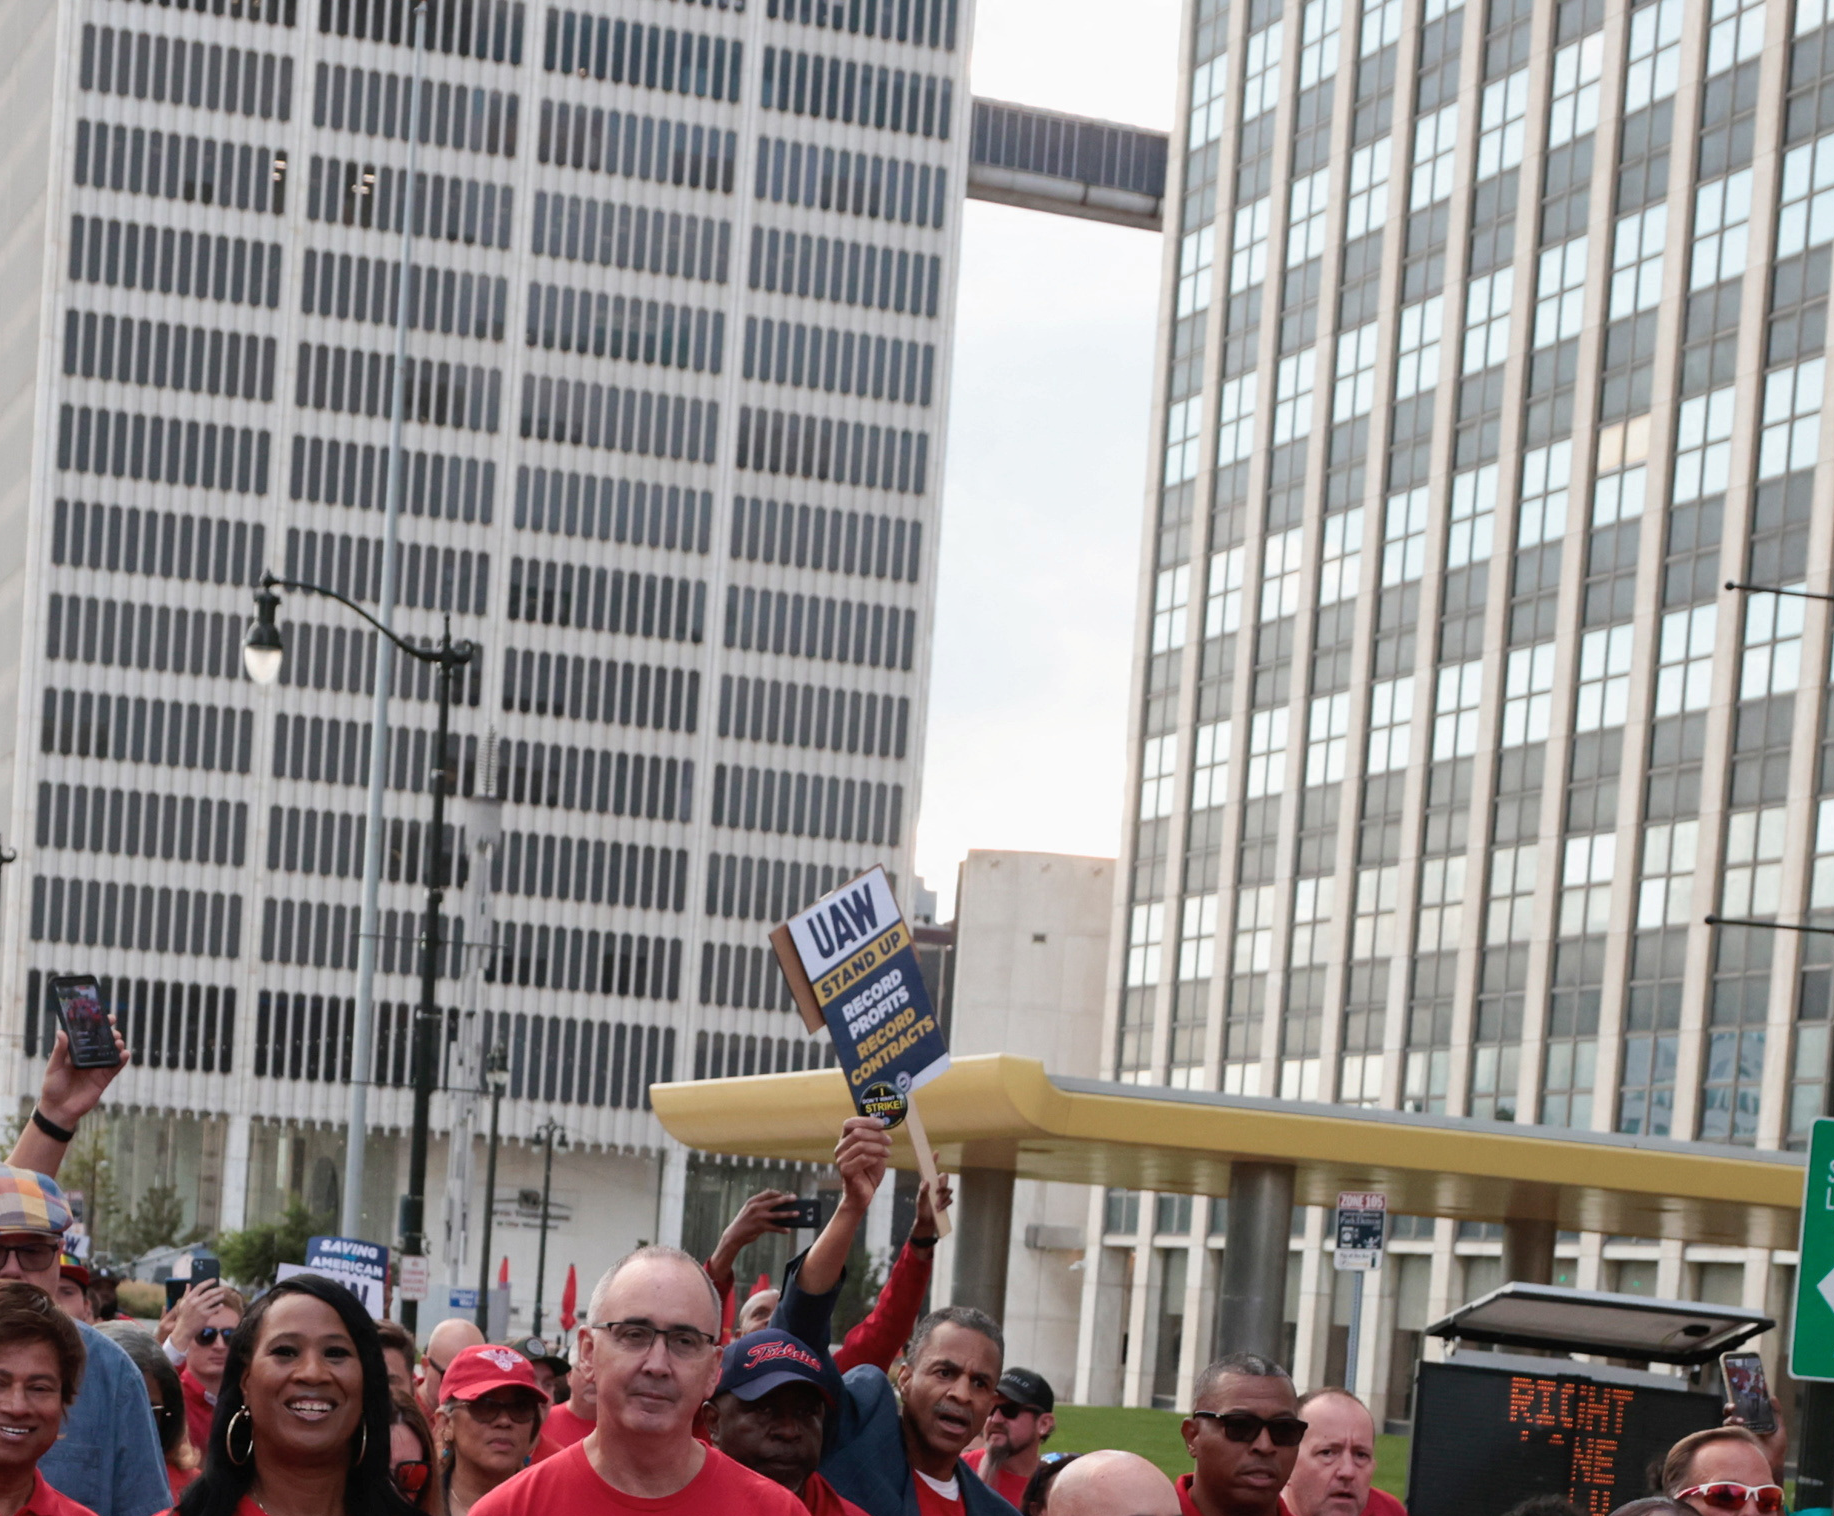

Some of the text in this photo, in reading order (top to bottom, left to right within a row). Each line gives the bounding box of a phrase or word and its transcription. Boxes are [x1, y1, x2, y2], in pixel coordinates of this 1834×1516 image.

[808, 882, 879, 960] UAW
[821, 930, 901, 999] STAND UP
[842, 968, 903, 1023] RECORD
[848, 985, 910, 1040] PROFITS
[851, 1014, 935, 1086] CONTRACTS
[856, 1006, 916, 1060] RECORD
[866, 1100, 903, 1113] STRIKE!
[1340, 1194, 1364, 1207] ZONE
[310, 1257, 383, 1278] AMERICAN
[320, 1239, 378, 1260] SAVING
[1509, 1377, 1634, 1434] RIGHT
